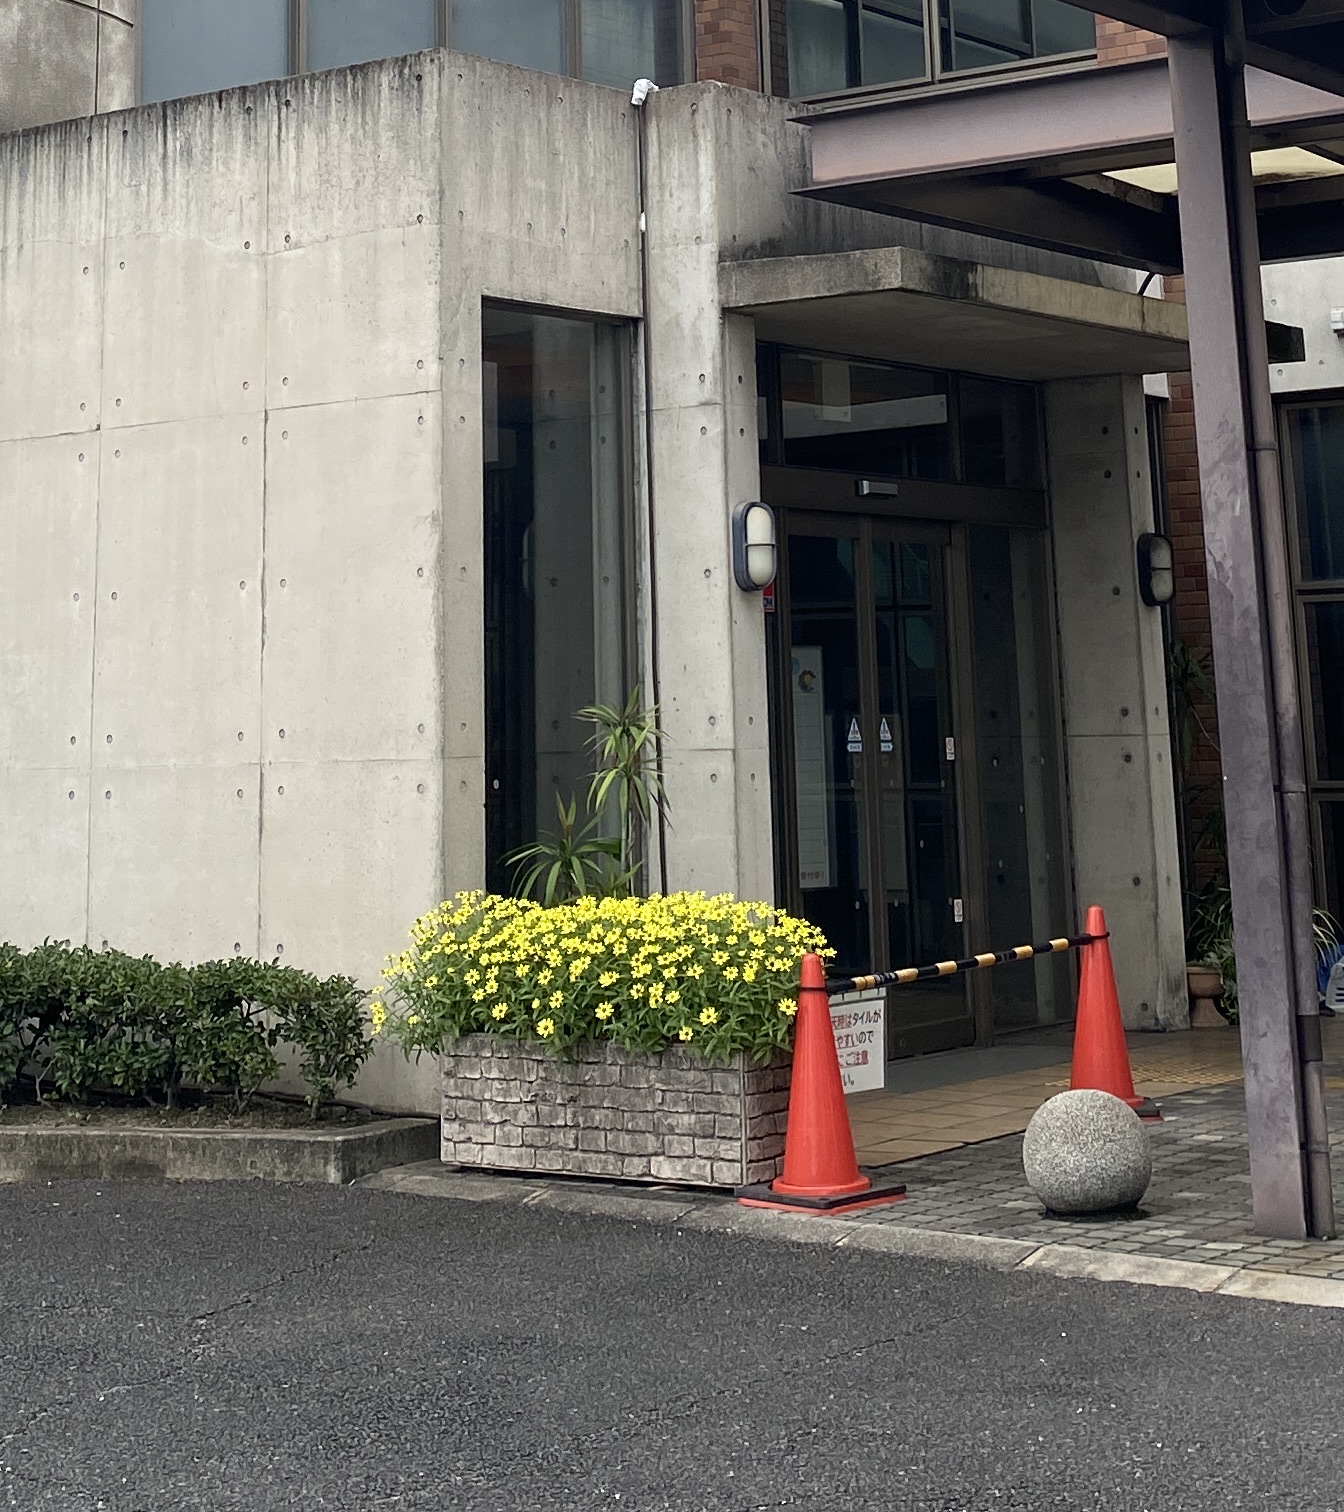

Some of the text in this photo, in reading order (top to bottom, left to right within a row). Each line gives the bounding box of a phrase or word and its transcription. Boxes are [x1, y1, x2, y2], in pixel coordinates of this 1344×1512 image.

[836, 1031, 875, 1048] やすいので
